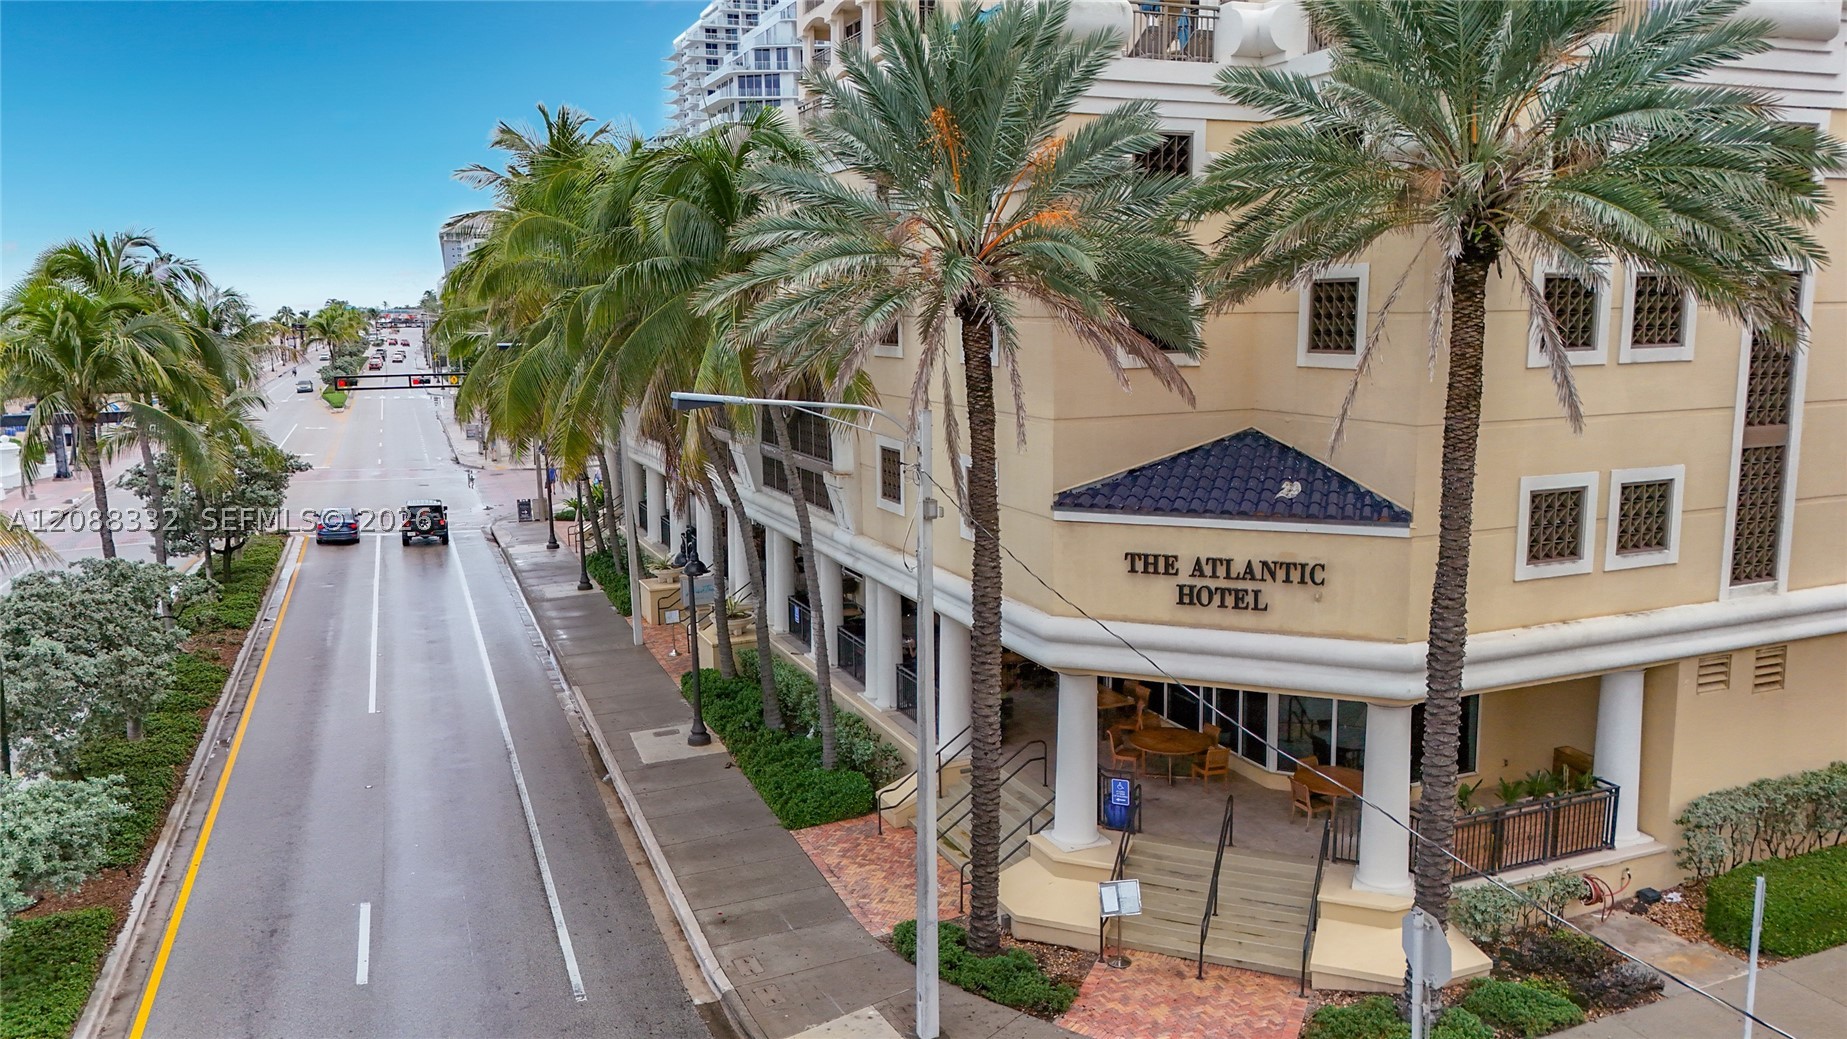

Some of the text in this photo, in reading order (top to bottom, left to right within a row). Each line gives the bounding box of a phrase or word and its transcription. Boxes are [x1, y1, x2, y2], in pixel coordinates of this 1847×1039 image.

[1124, 552, 1326, 587] THE ATLANTIC
[1175, 583, 1268, 612] HOTEL
